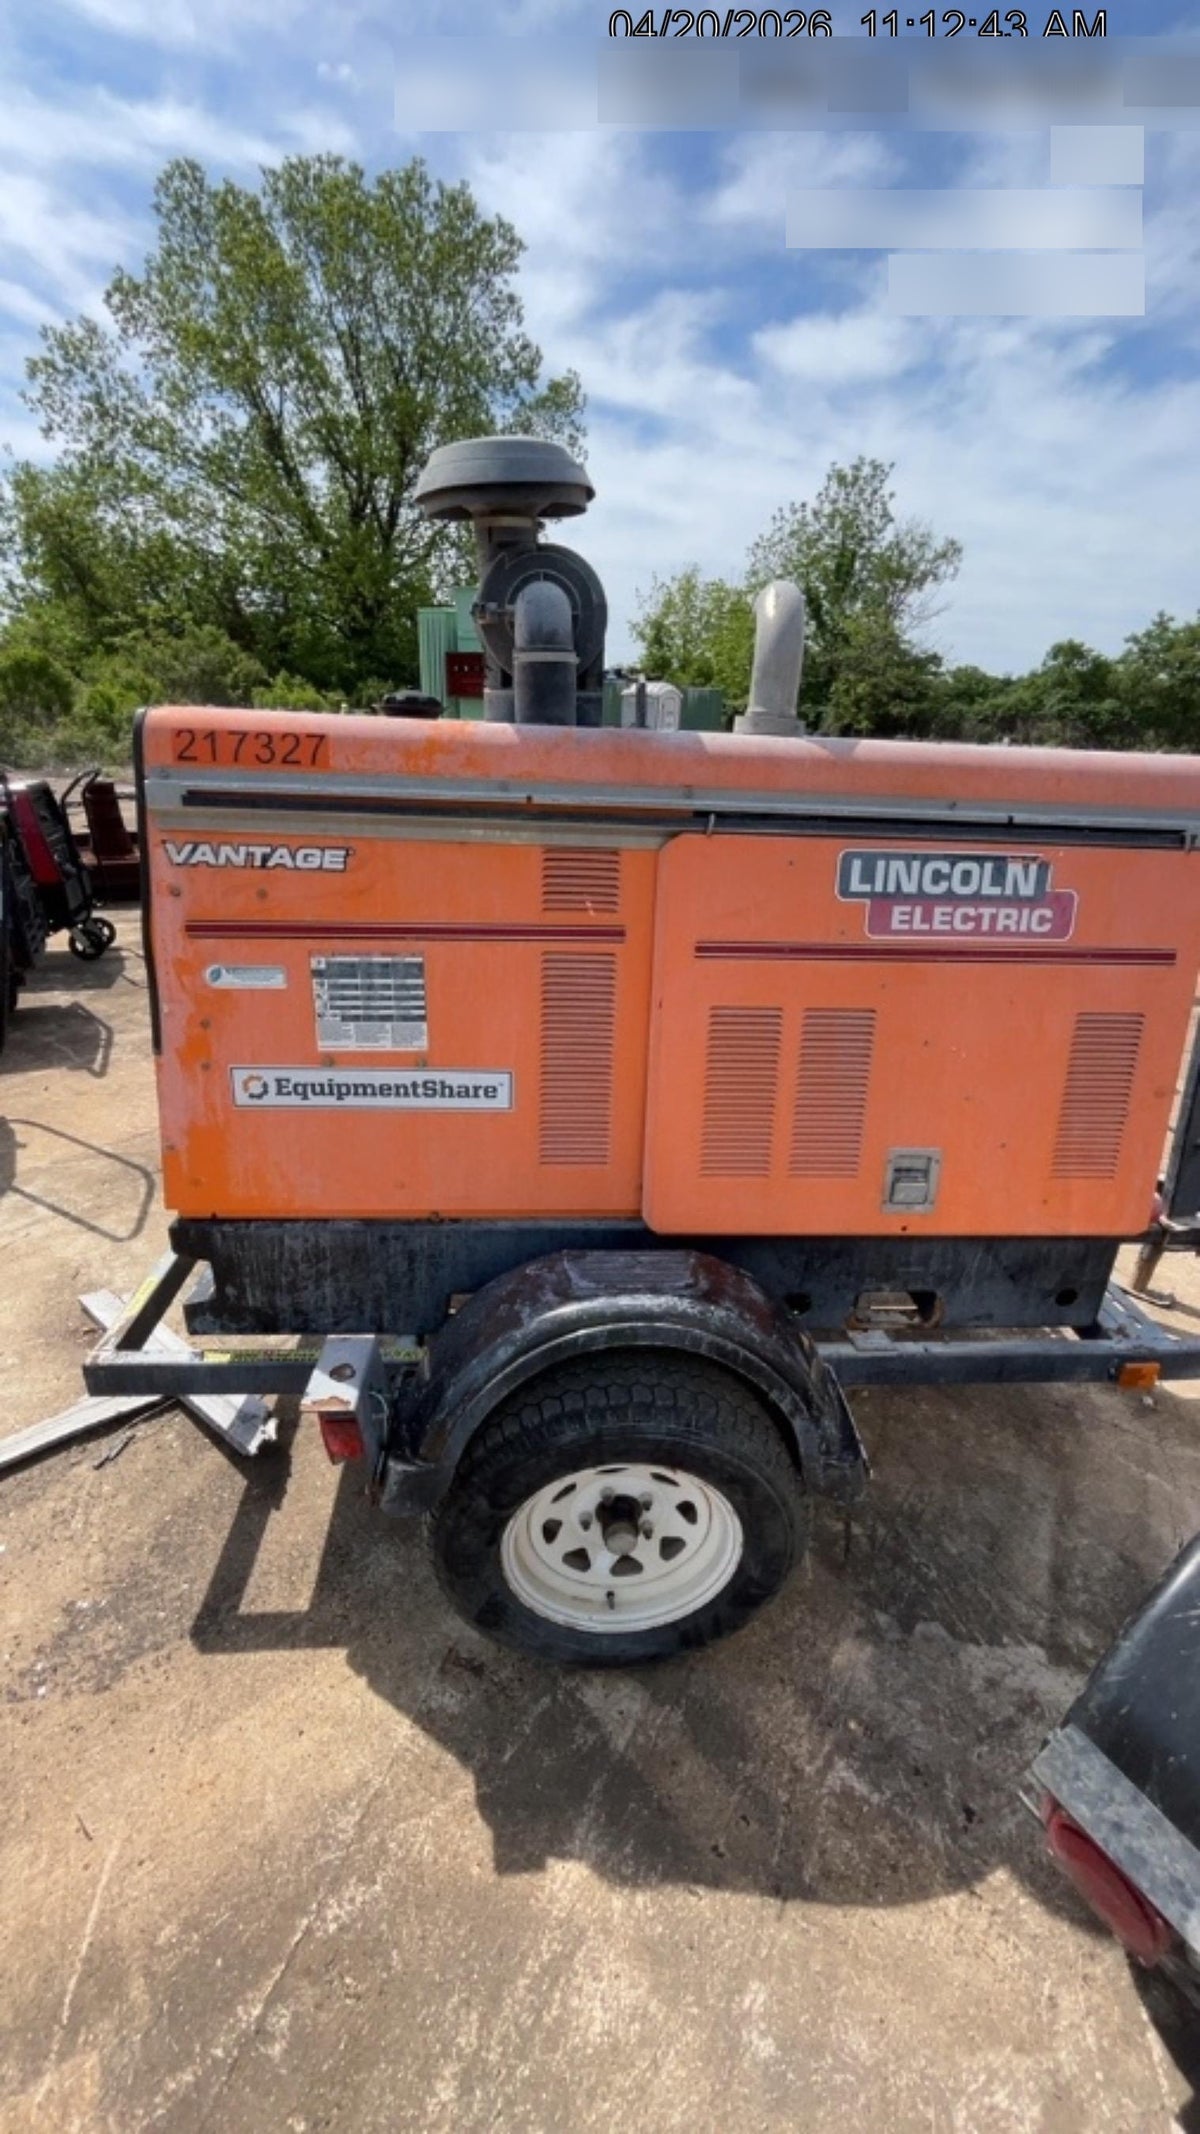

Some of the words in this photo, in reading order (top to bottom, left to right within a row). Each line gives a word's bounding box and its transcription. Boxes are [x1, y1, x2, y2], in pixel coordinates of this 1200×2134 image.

[175, 730, 326, 766] 217327
[163, 840, 348, 872] VANTAGE
[848, 858, 1038, 897] LINCOLN
[890, 905, 1054, 933] ELECTRIC
[274, 1078, 499, 1100] EquipmentShare
